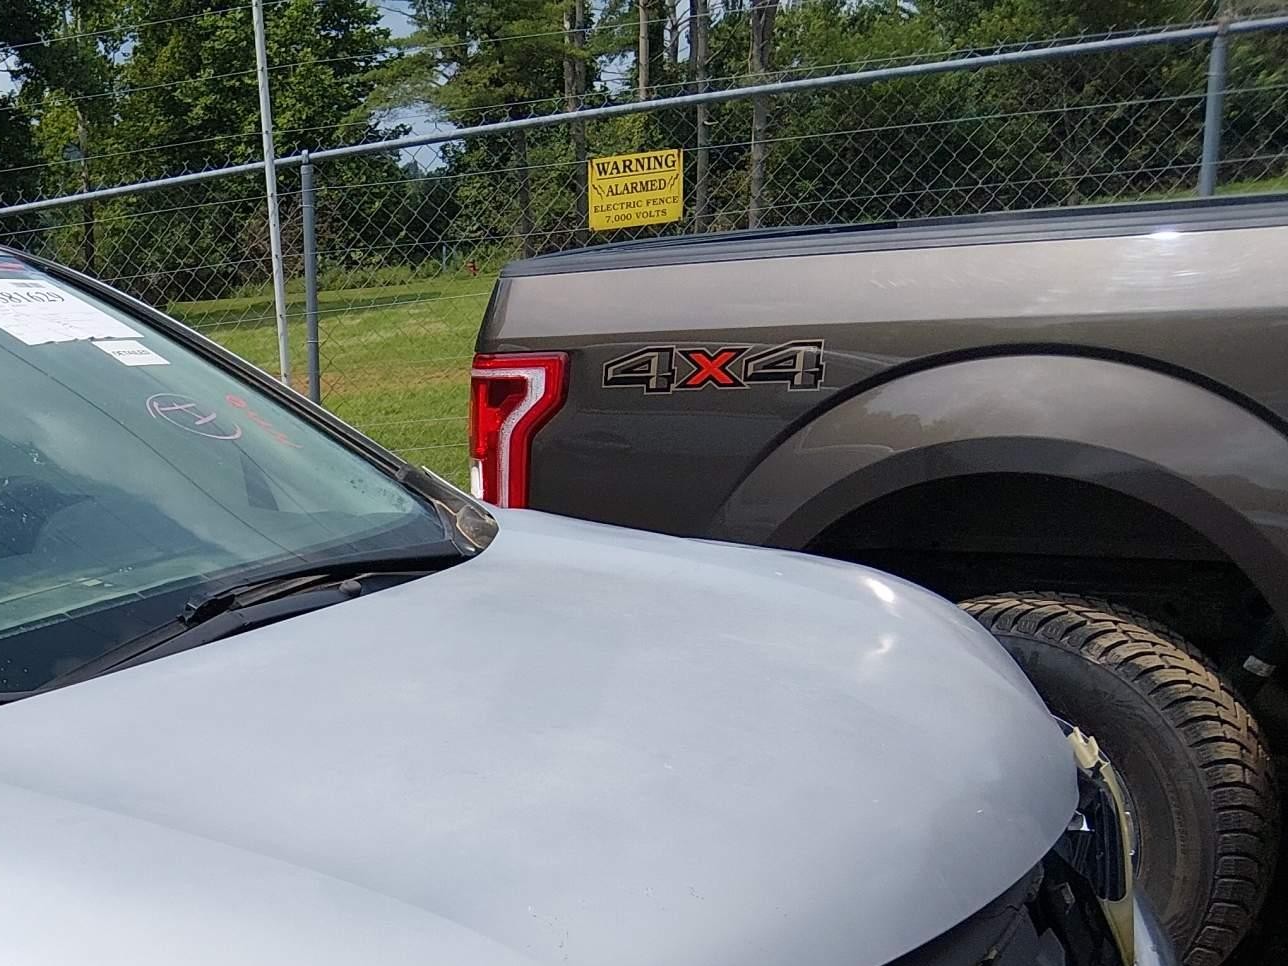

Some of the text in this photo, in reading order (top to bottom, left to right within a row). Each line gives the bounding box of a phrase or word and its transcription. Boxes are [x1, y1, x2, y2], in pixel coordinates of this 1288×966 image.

[596, 154, 676, 177] WARNING
[606, 178, 667, 197] ALARMED
[594, 196, 679, 213] ELECTRIC FENCE
[605, 209, 667, 224] 7,000 VOLTS
